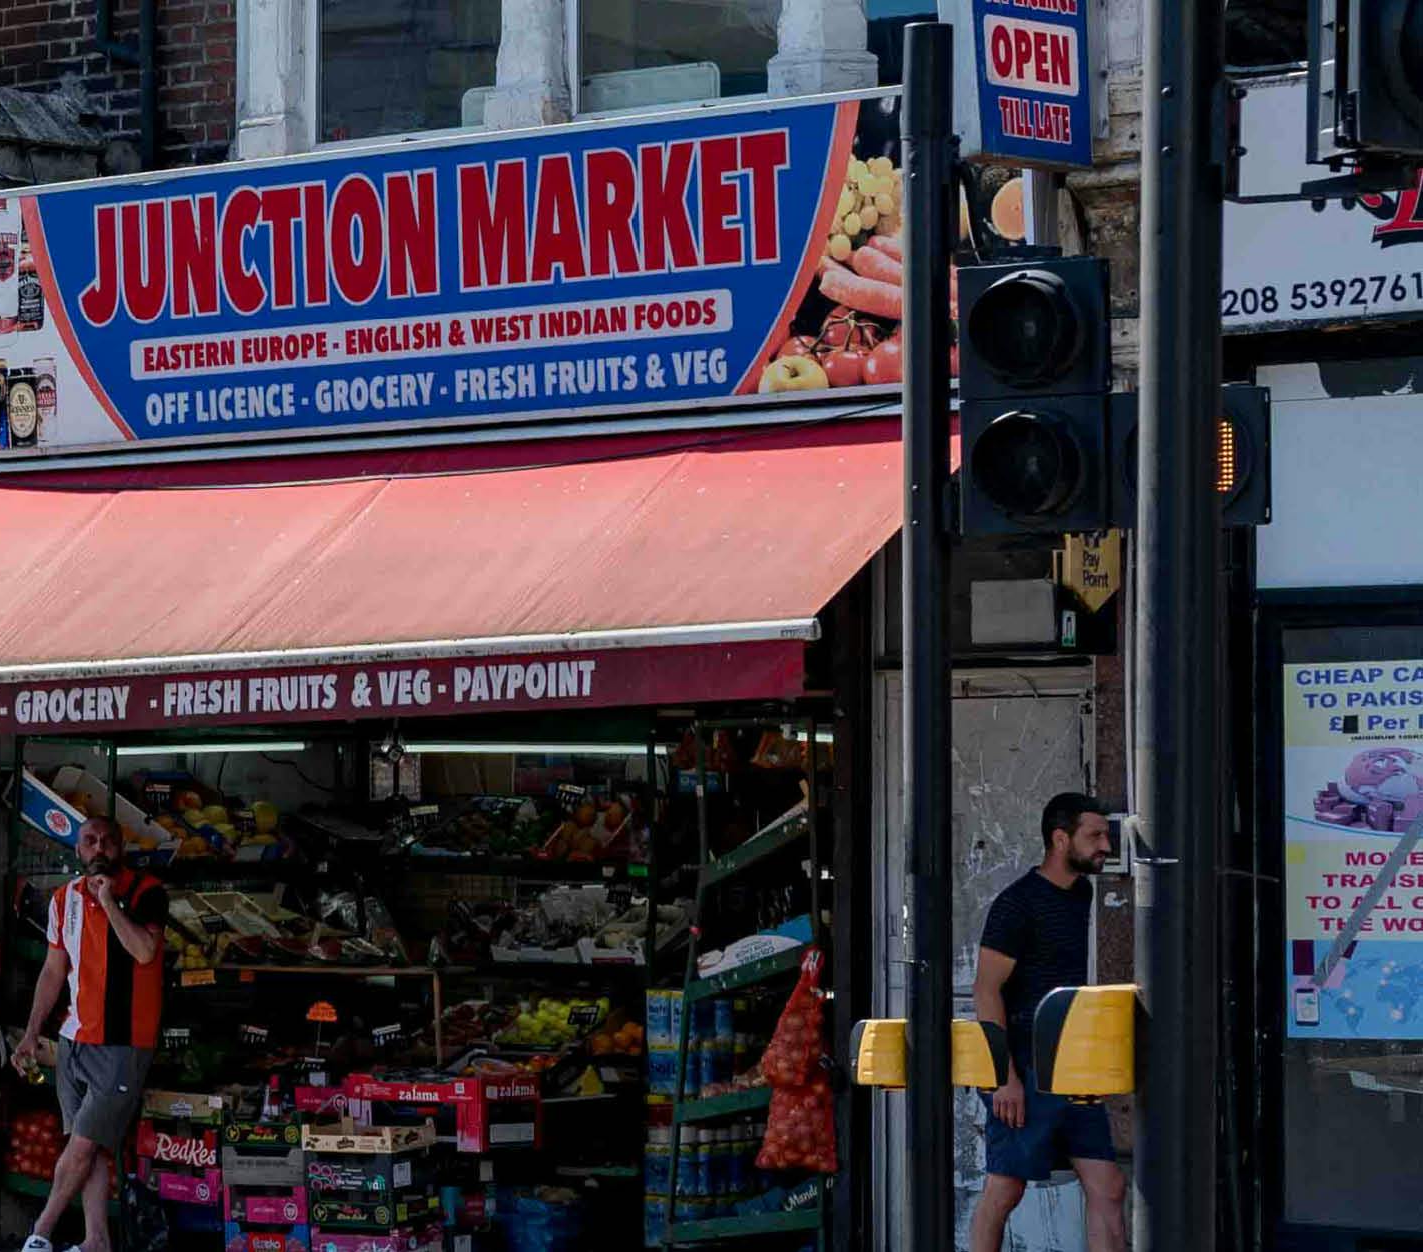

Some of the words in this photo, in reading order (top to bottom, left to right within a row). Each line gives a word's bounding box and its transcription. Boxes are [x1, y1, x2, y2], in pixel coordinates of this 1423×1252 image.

[991, 25, 1071, 86] OPEN
[998, 96, 1034, 139] TILL
[1034, 101, 1072, 144] LATE
[78, 168, 440, 327] JUNCTION
[456, 127, 790, 293] MARKET
[143, 340, 235, 372] EASTERN
[242, 332, 328, 364] EUROPE
[345, 319, 442, 355] ENGLISH
[448, 319, 466, 346] &
[471, 315, 533, 343] WEST
[539, 305, 627, 339] INDIAN
[635, 298, 716, 330] FOODS
[146, 391, 190, 426] OFF
[196, 383, 295, 422] LICENCE
[315, 371, 435, 414] GROCERY
[455, 360, 536, 402] FRESH
[544, 354, 638, 395] FRUITS
[645, 354, 665, 387] &
[671, 347, 728, 385] VEG
[1083, 551, 1100, 572] Pay
[1083, 569, 1109, 587] Point
[1296, 667, 1384, 685] CHEAP
[15, 685, 130, 723] GROCERY
[163, 678, 241, 717] FRESH
[248, 674, 338, 712] FRUITS
[351, 672, 372, 708] &
[378, 669, 431, 706] VEG
[454, 660, 596, 703] PAYPOINT
[1302, 692, 1337, 709] TO
[1346, 690, 1423, 708] PAKIS
[1367, 715, 1409, 730] Per
[1305, 896, 1341, 909] TO
[398, 1085, 440, 1101] zalama
[499, 1079, 537, 1097] zalama
